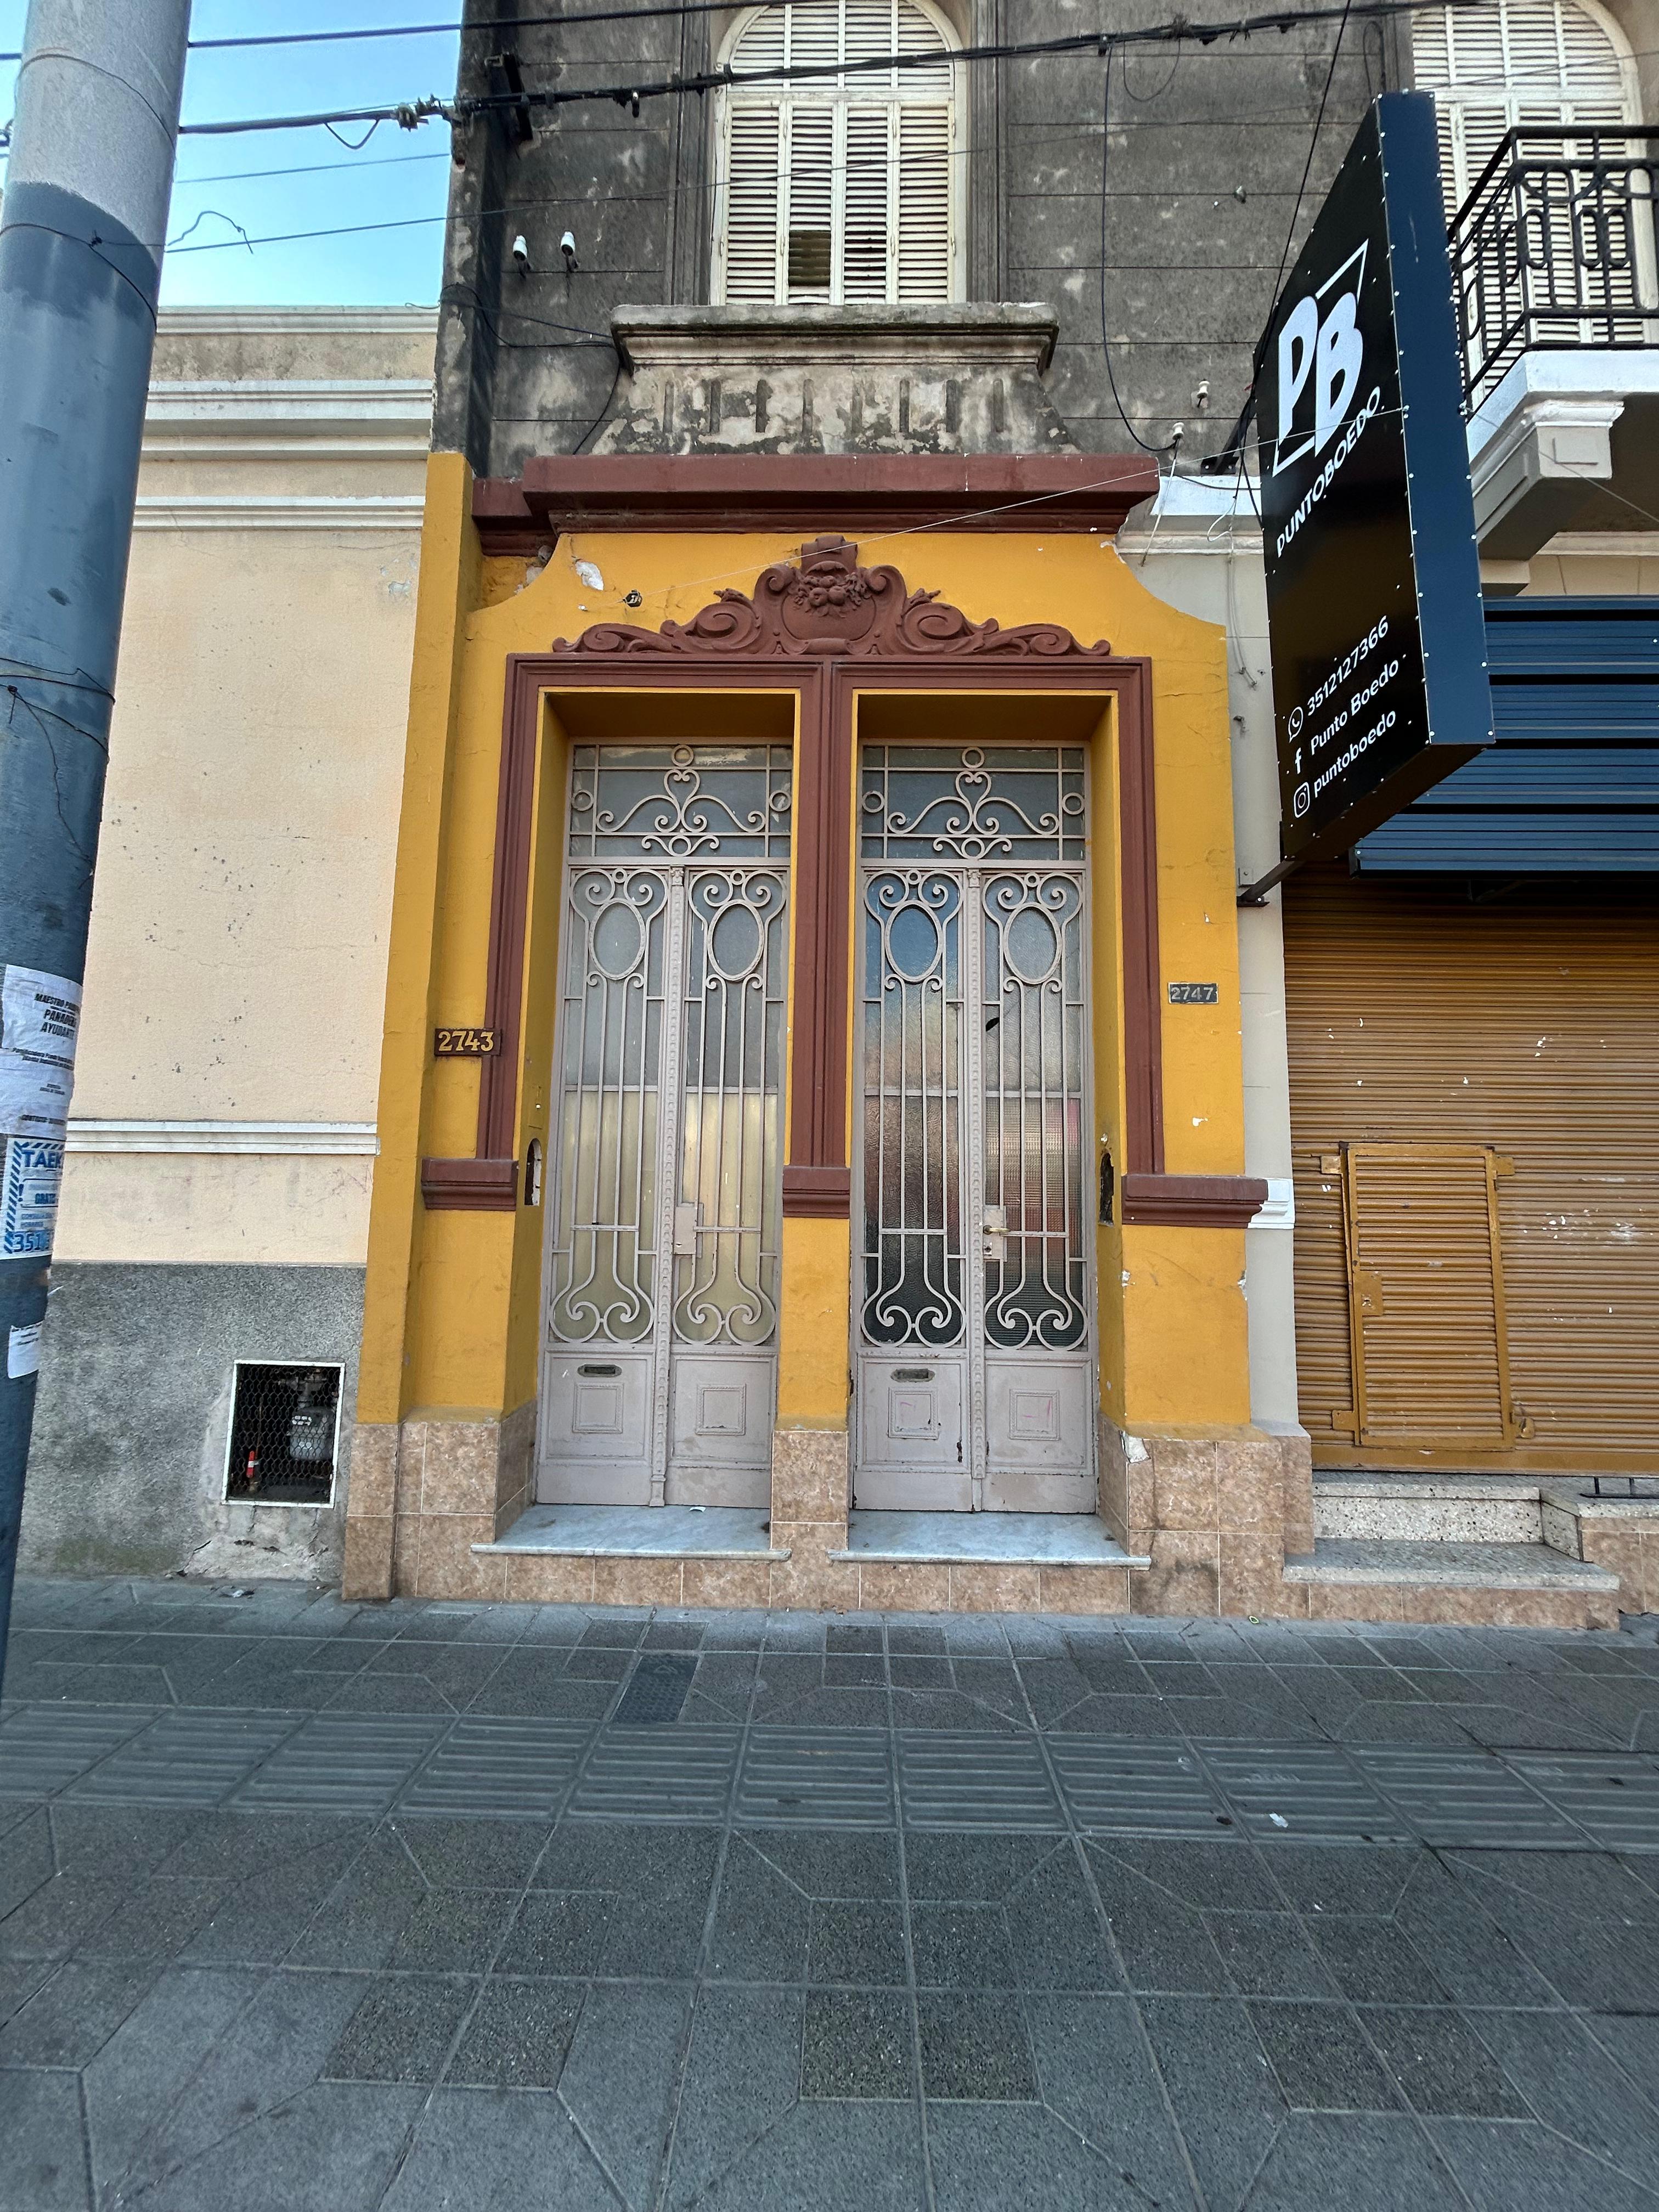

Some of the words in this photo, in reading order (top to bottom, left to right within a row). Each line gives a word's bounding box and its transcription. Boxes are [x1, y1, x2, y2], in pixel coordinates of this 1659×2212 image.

[1279, 296, 1363, 457] PB
[1277, 386, 1380, 557] PUNTOBOEDO
[1307, 615, 1389, 716] 3512127366
[1310, 711, 1347, 755] Punto
[1351, 660, 1399, 715] Boedo
[1314, 711, 1396, 798] puntoboedo
[1171, 986, 1214, 1000] 2747
[438, 1031, 494, 1051] 2743
